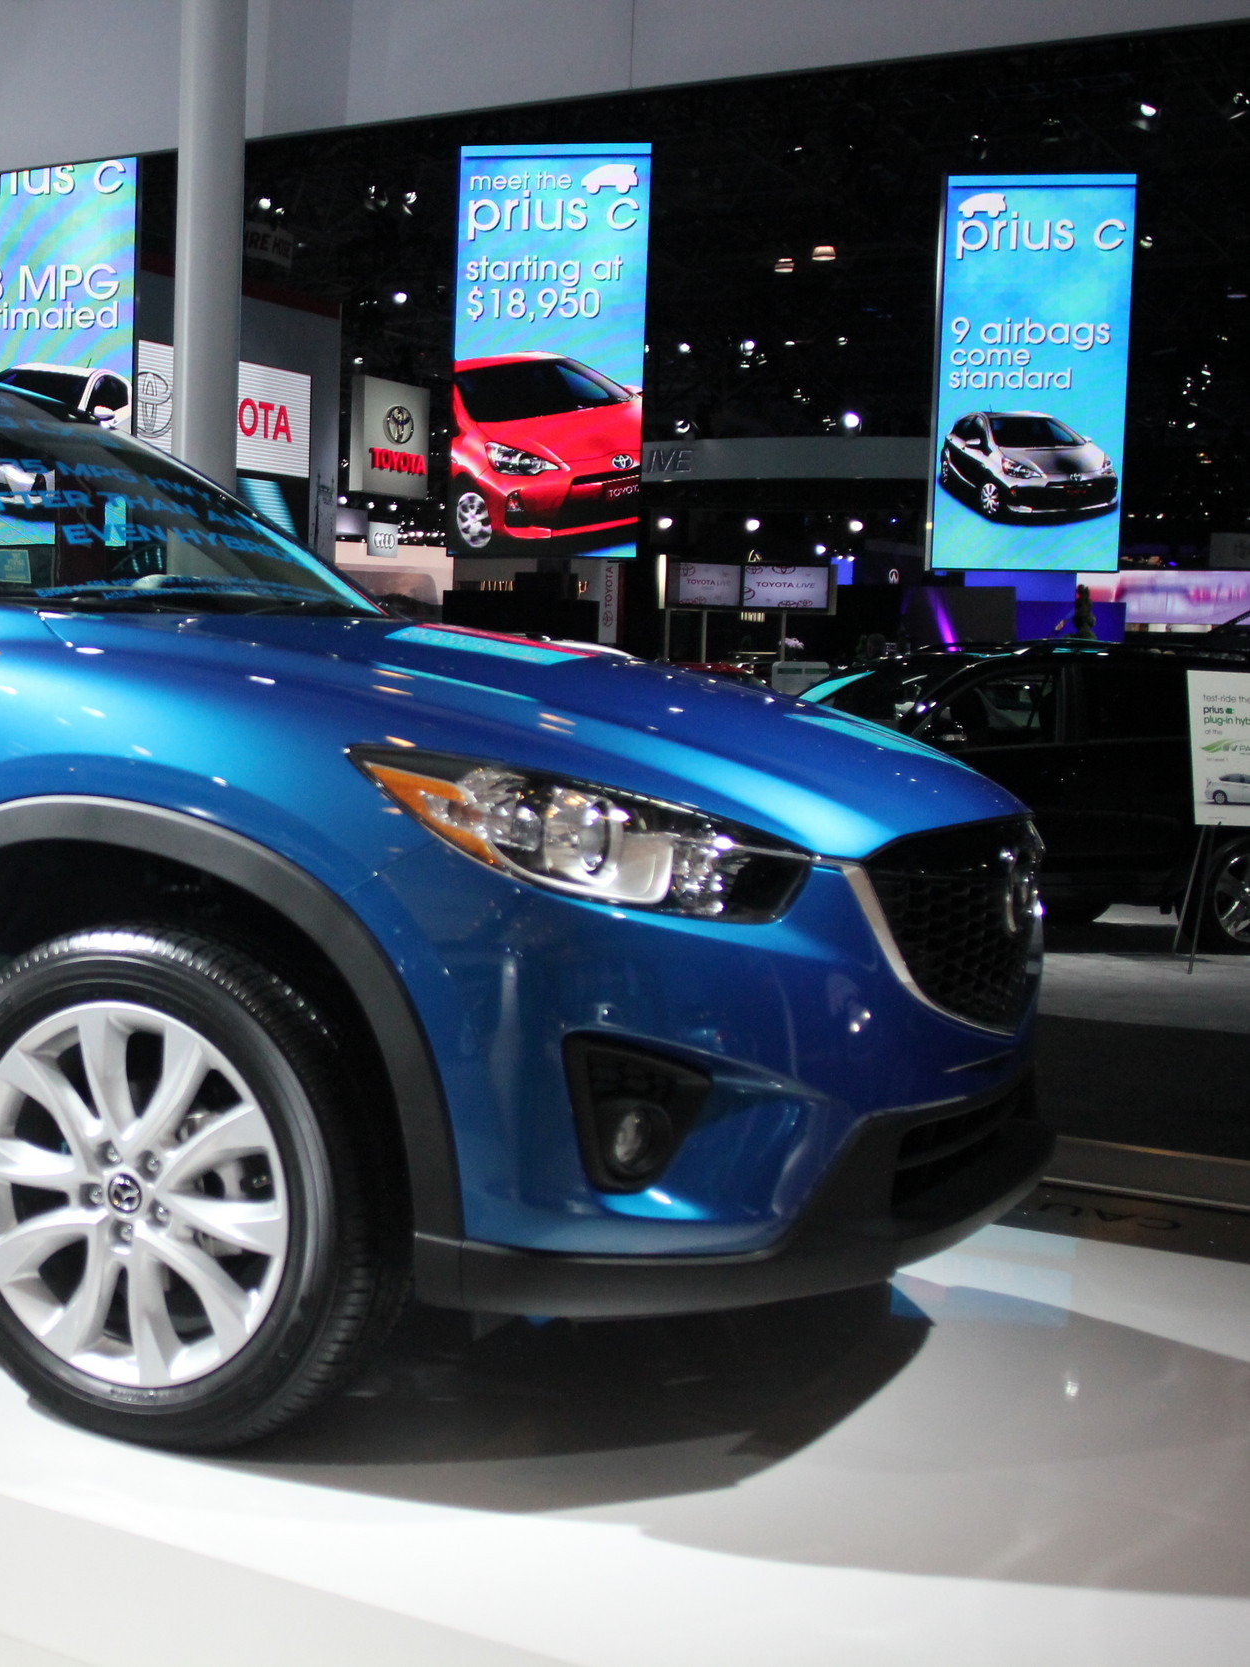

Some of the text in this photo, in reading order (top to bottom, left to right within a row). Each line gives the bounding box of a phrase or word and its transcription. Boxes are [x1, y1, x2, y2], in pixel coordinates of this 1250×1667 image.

[93, 160, 126, 194] c
[470, 171, 573, 191] meet the
[467, 190, 640, 241] prius c
[956, 211, 1127, 260] prius c
[19, 264, 120, 301] MPG
[466, 255, 624, 287] starting at
[466, 286, 602, 322] $18,950
[951, 316, 1112, 351] 9 airbags
[950, 348, 1031, 366] come
[949, 367, 1073, 390] standard
[54, 460, 140, 484] MPG
[369, 447, 427, 476] TOYOTA
[609, 484, 640, 498] TOYOT
[97, 491, 198, 518] THAN
[61, 523, 167, 545] EVEN
[604, 566, 614, 609] TOYOTA
[687, 578, 716, 586] TOYOTA
[1203, 694, 1236, 703] test-ride
[1203, 705, 1224, 715] prius
[1204, 715, 1233, 726] plug-in
